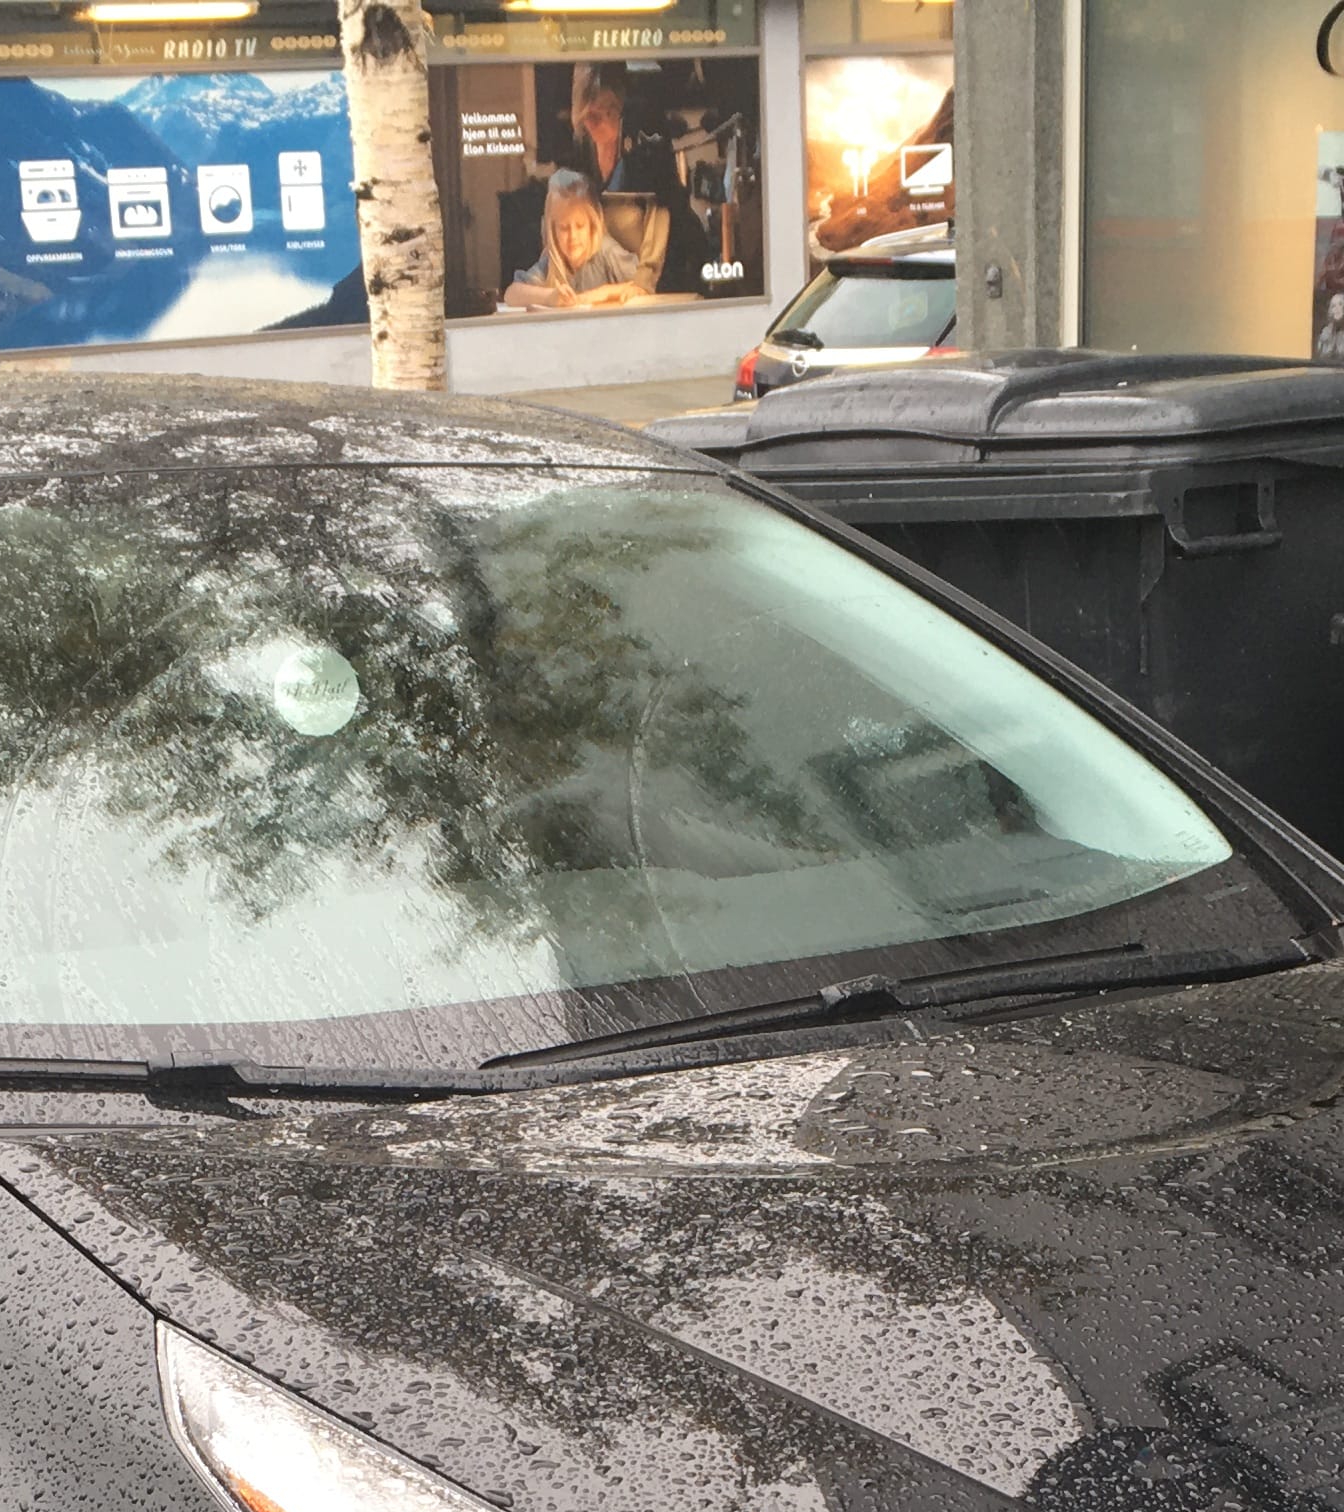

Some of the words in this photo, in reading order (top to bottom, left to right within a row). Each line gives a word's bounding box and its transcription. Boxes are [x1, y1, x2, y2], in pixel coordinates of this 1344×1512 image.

[592, 28, 663, 48] ELEKTRO
[163, 38, 227, 60] RADIO
[234, 37, 257, 57] TV
[460, 112, 517, 125] Velkommen
[462, 127, 487, 141] hjem
[488, 126, 500, 139] til
[501, 128, 516, 139] oss
[463, 143, 485, 155] Elon
[486, 141, 525, 154] Kirkenes
